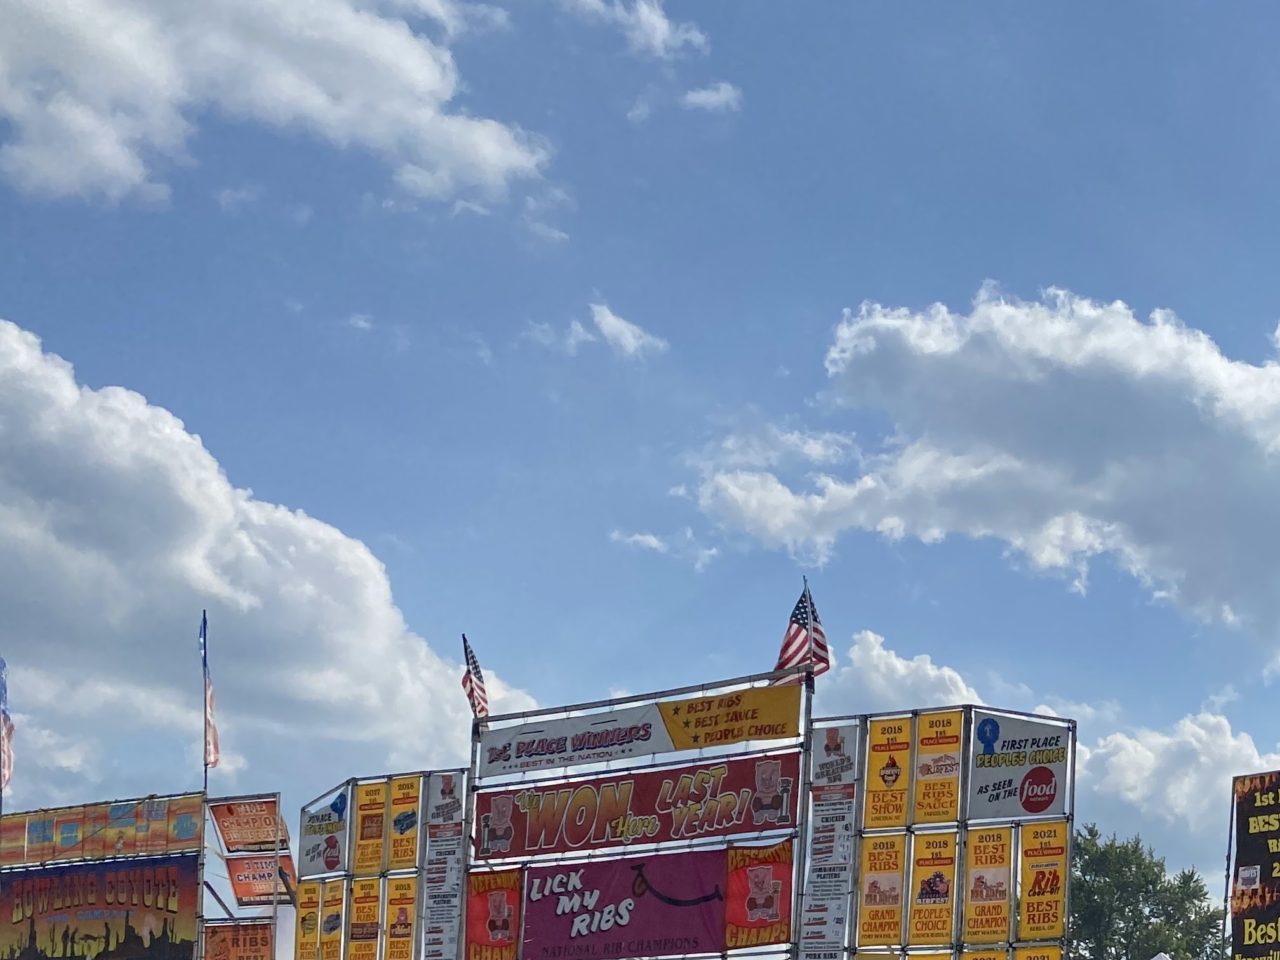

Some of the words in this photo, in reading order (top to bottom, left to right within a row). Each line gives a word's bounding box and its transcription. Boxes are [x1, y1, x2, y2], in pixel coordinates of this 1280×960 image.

[687, 700, 713, 714] BEST
[718, 695, 742, 709] RIBS
[694, 715, 720, 728] BEST
[724, 708, 759, 724] SAUCE
[928, 719, 952, 728] 2018
[880, 726, 903, 735] 2018
[487, 742, 512, 764] 1st
[515, 736, 568, 759] PLACE
[571, 723, 652, 752] WINNERS
[1000, 738, 1028, 751] FIRST
[1031, 735, 1061, 749] PLACE
[519, 759, 543, 768] BEST
[578, 751, 613, 760] NATION
[975, 751, 1026, 768] PEOPLES
[1029, 748, 1066, 764] CHOICE
[655, 764, 728, 814] LAST
[923, 781, 953, 791] BEST
[977, 785, 989, 795] AS
[991, 779, 1013, 792] SEEN
[1019, 778, 1056, 803] food
[872, 792, 905, 803] BEST
[922, 789, 954, 798] RIBS
[988, 792, 1001, 802] ON
[1001, 787, 1018, 799] THE
[1254, 791, 1275, 807] 1st
[871, 802, 904, 815] SHOW
[916, 800, 956, 810] SAUCE
[525, 779, 634, 850] WON
[671, 788, 751, 838] YEAR!
[610, 811, 659, 844] Here
[978, 834, 1002, 843] 2018
[1032, 830, 1057, 839] 2021
[393, 837, 416, 848] BEST
[925, 840, 948, 849] 2018
[393, 848, 414, 858] RIBS
[973, 843, 1007, 855] BEST
[868, 851, 900, 862] BEST
[974, 854, 1005, 865] RIBS
[869, 861, 899, 871] RIBS
[529, 868, 585, 901] LICK
[556, 889, 600, 916] MY
[1026, 900, 1061, 913] BEST
[356, 905, 376, 913] BEST
[869, 909, 895, 920] GRAND
[913, 907, 950, 919] PEOPLE'S
[974, 905, 1003, 916] GRAND
[356, 912, 376, 921] RIBS
[570, 898, 635, 938] RIBS
[967, 916, 1008, 929] CHAMPION
[1027, 912, 1059, 925] RIBS
[862, 921, 899, 932] CHAMPION
[915, 920, 948, 931] CHOICE
[231, 937, 269, 947] RIBS
[390, 941, 410, 949] BEST
[542, 943, 598, 958] NATIONAL
[603, 942, 622, 954] RIB
[628, 935, 699, 951] CHAMPIONS
[389, 950, 410, 959] RIBS
